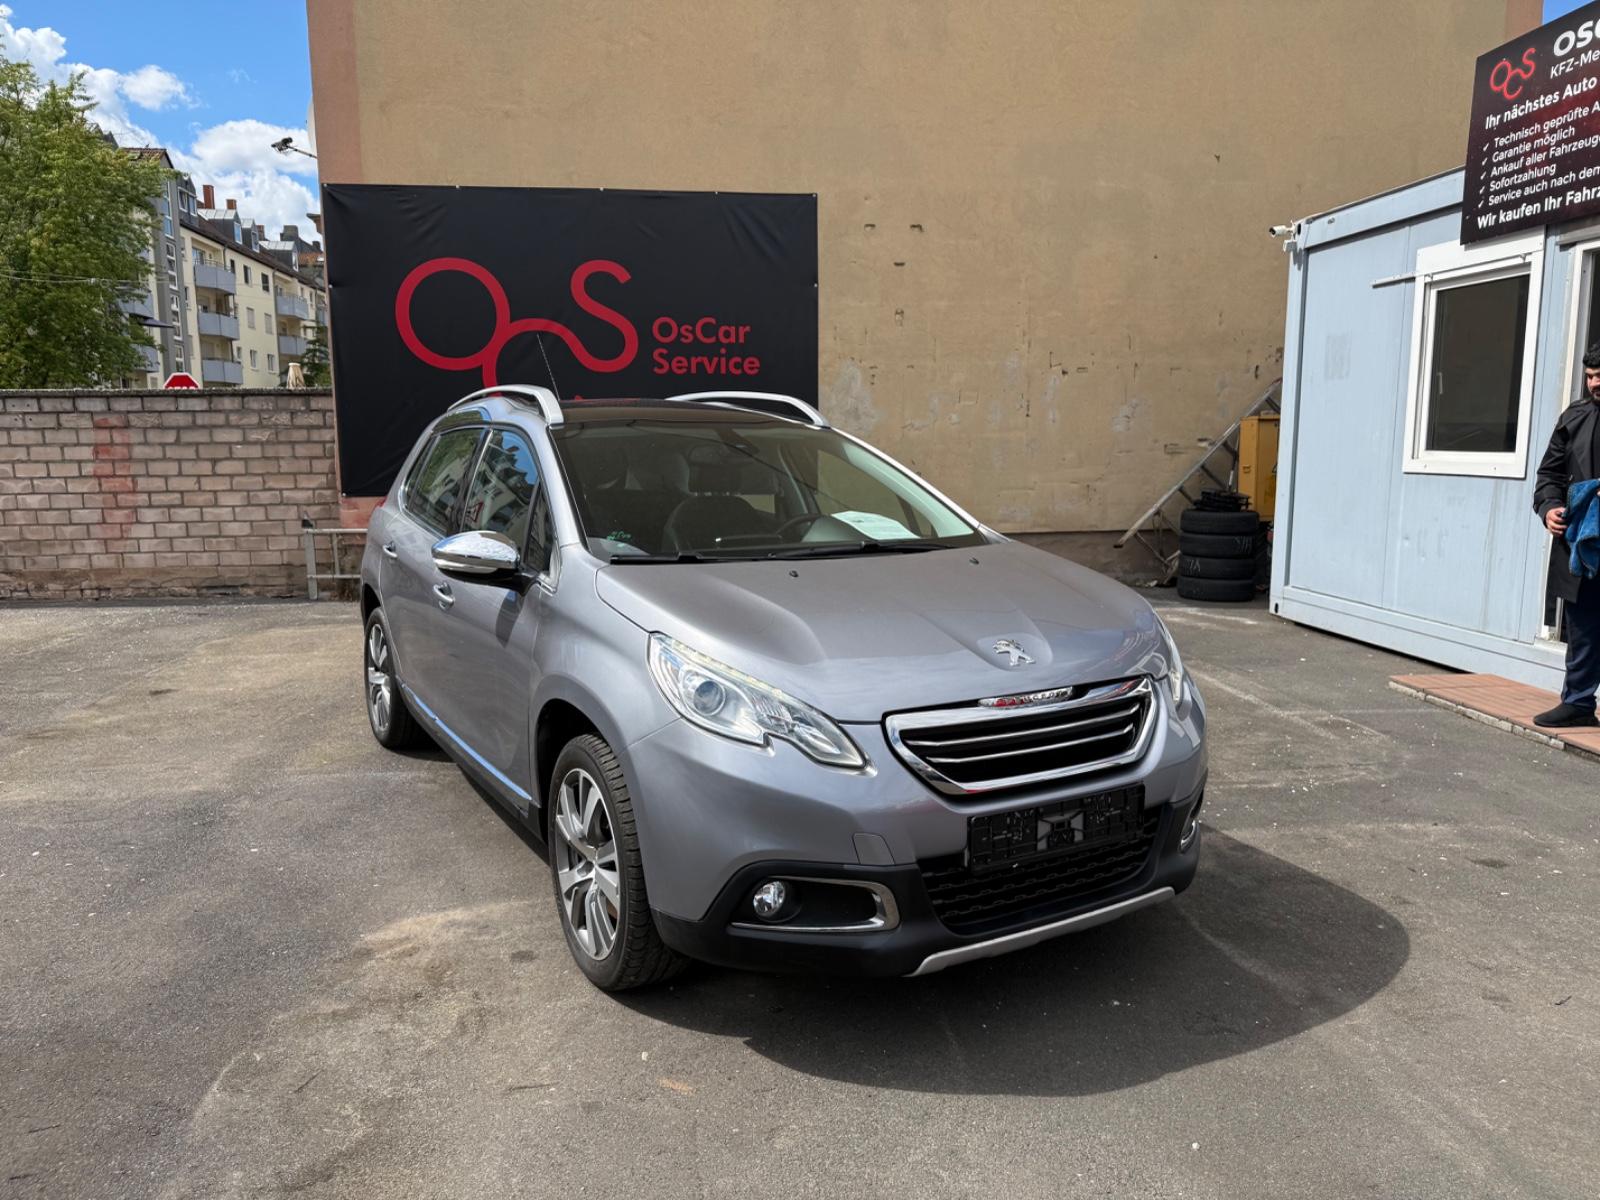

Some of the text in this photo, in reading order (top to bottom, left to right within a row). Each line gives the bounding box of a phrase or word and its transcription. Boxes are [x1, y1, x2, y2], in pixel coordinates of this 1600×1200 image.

[1485, 76, 1598, 130] Ihr nächstes Auto
[1492, 125, 1575, 163] Garantie möglich
[1494, 122, 1541, 148] Technisch
[1543, 107, 1590, 133] geprüfte
[1489, 163, 1557, 192] Sofortzahlung
[1490, 156, 1524, 177] Ankauf
[1525, 151, 1548, 166] aller
[1488, 188, 1521, 206] Service
[1523, 179, 1548, 196] auch
[1550, 171, 1576, 188] nach
[1477, 212, 1497, 230] Wir
[1499, 202, 1541, 224] kaufen
[1544, 196, 1563, 212] Ihr
[652, 316, 751, 344] OsCar
[652, 347, 761, 375] Service
